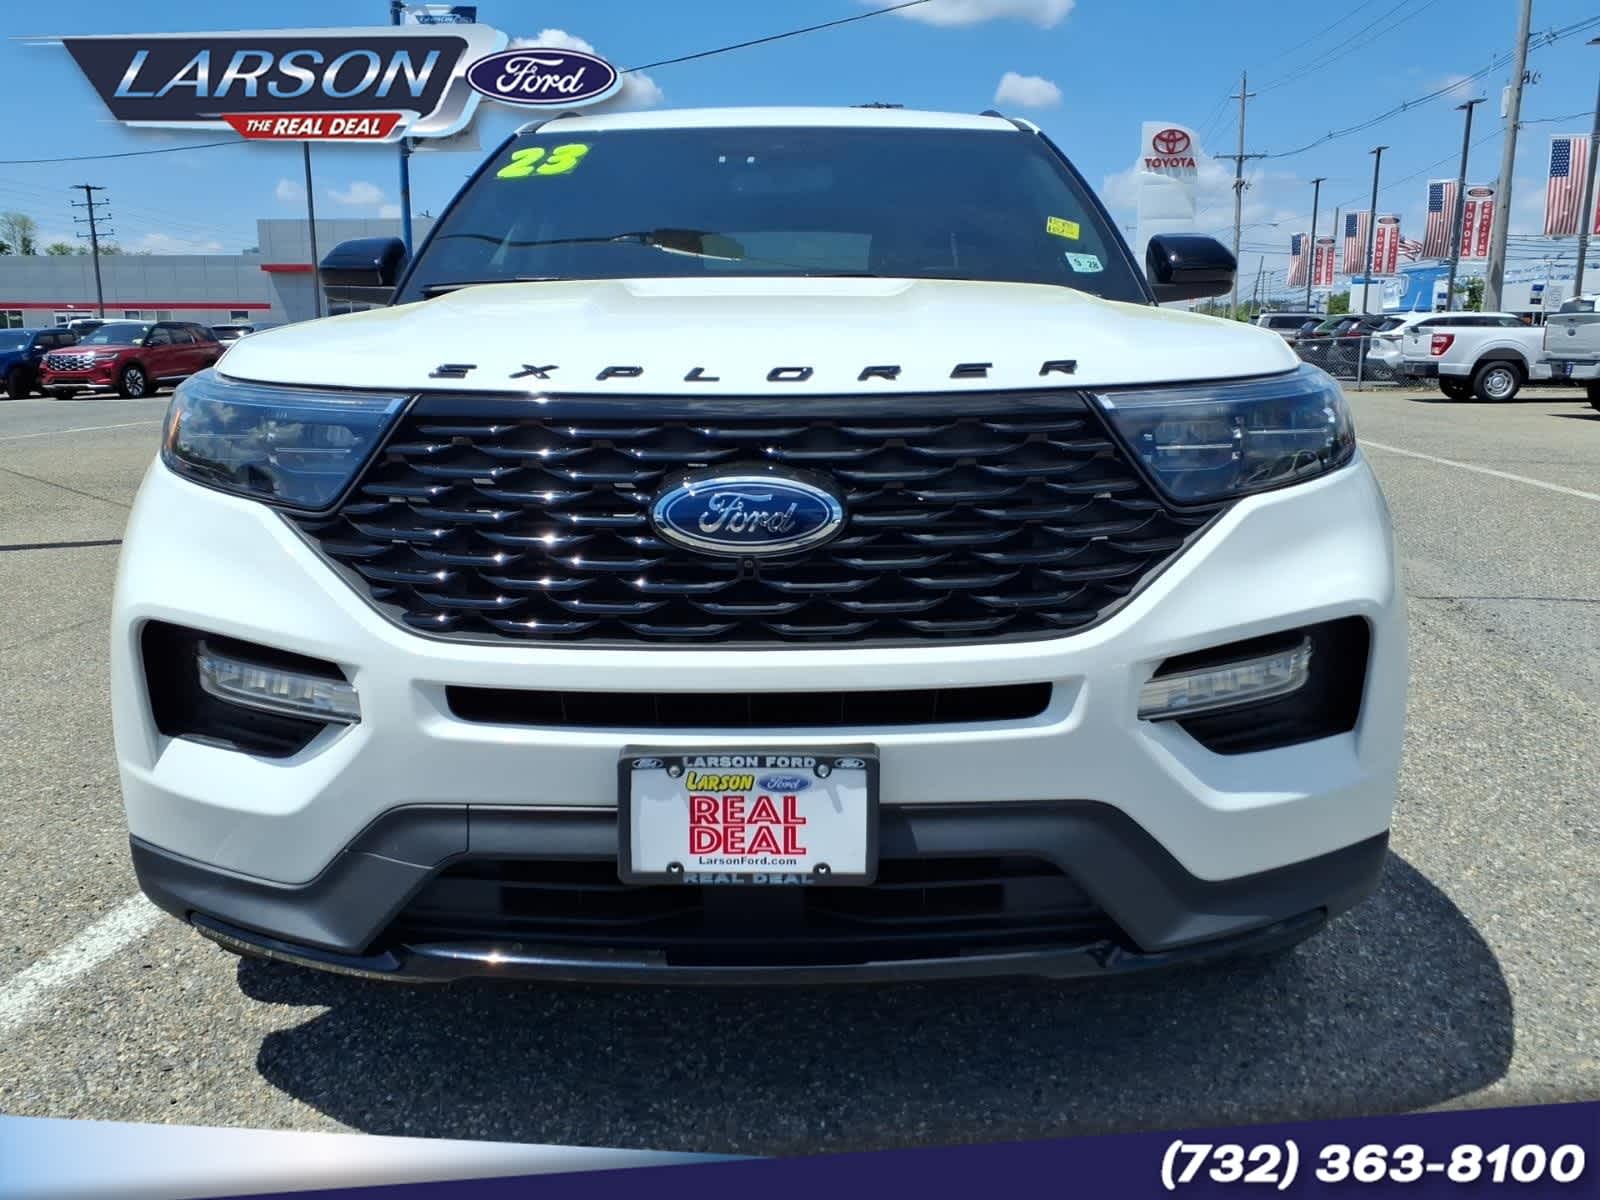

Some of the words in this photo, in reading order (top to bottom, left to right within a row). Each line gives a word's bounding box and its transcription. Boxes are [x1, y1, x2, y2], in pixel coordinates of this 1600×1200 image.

[496, 143, 589, 178] 23
[1144, 157, 1196, 168] TOYOTA
[1462, 202, 1475, 256] TOYOTA
[428, 359, 1077, 379] EXPLORER
[699, 492, 798, 533] Ford
[683, 756, 758, 768] LARSON
[766, 757, 816, 768] FORD
[689, 795, 807, 825] REAL
[689, 825, 807, 855] DEAL
[699, 856, 797, 865] LarsonFord.com
